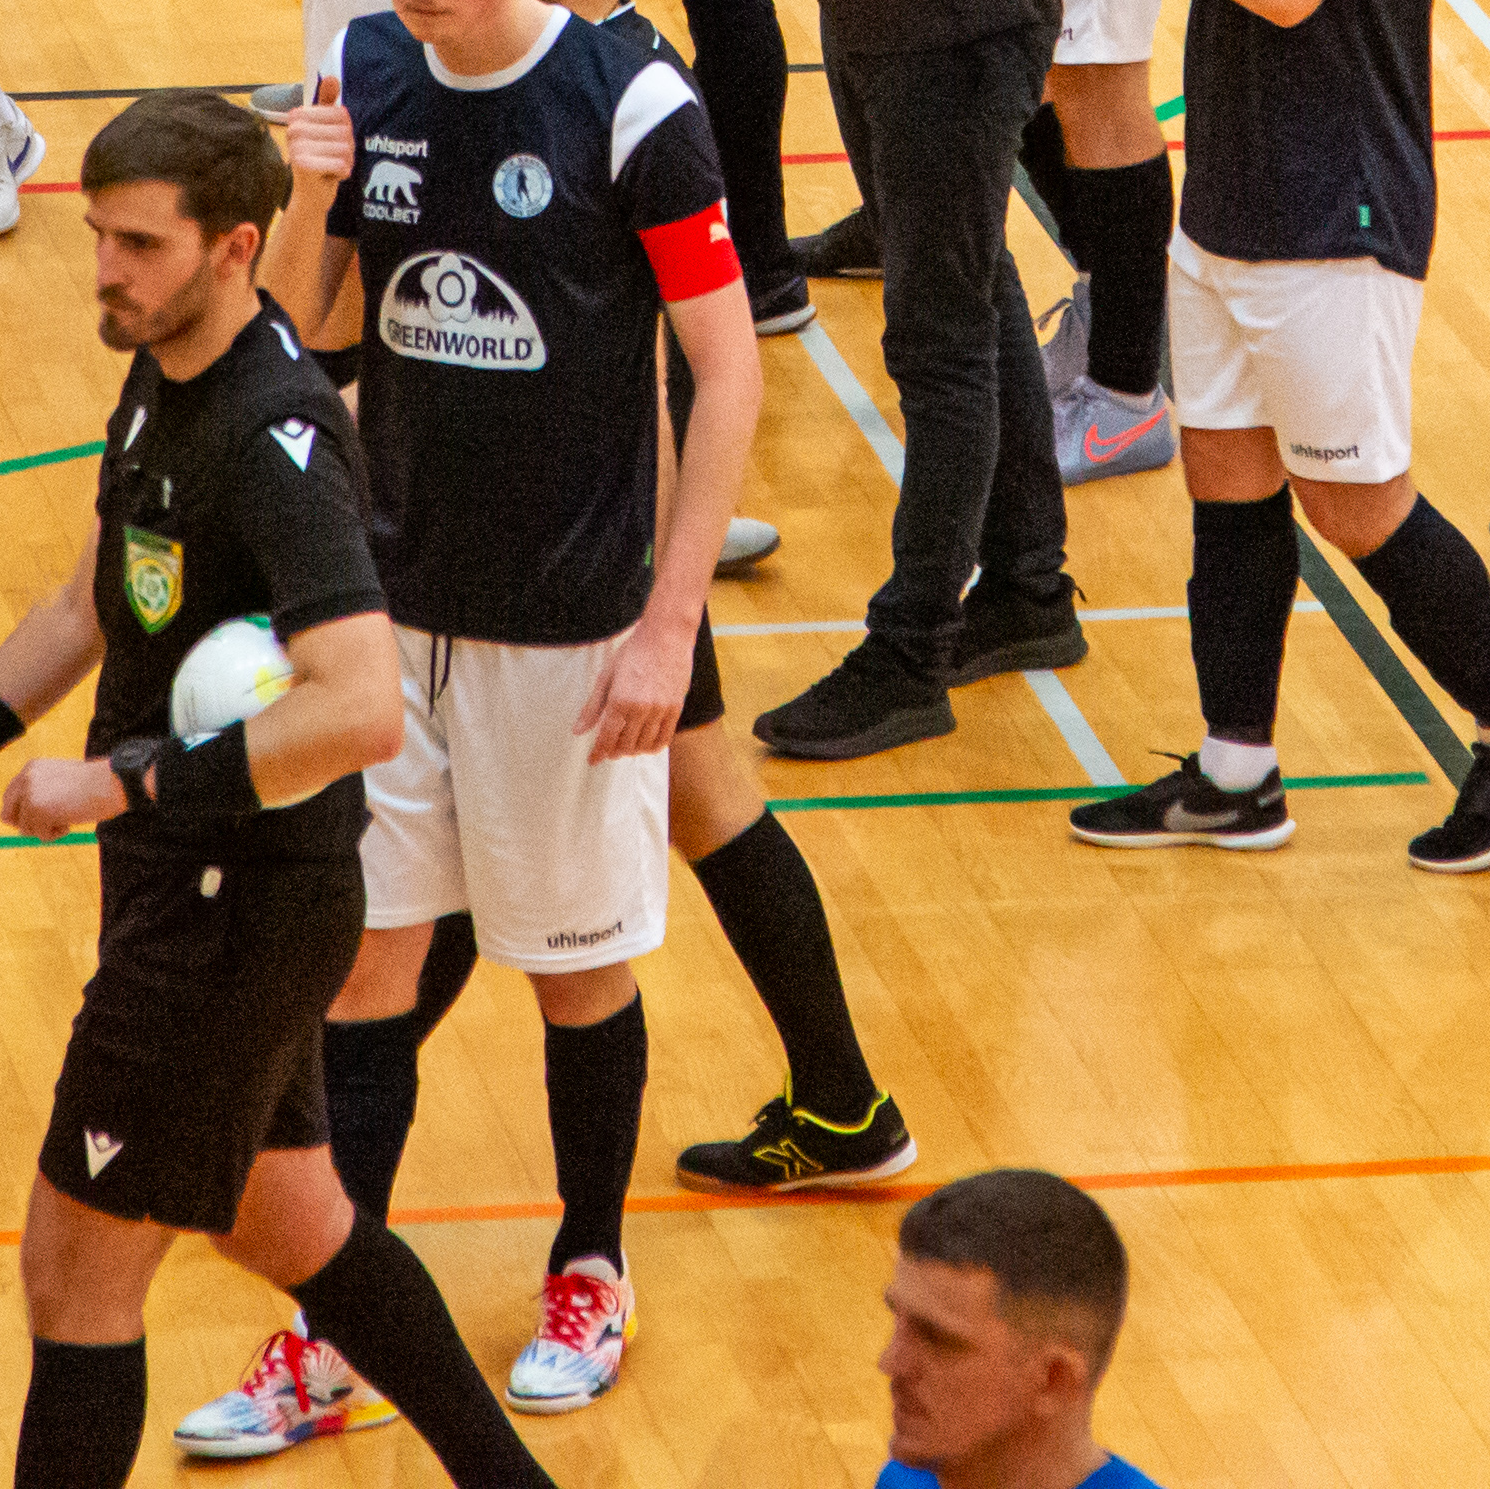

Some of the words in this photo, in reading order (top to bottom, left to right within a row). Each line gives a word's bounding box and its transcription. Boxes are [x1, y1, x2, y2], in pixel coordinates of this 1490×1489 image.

[364, 134, 429, 159] uhlsport
[387, 318, 533, 362] GREENWORLD
[1290, 443, 1360, 465] uhlsport
[547, 919, 623, 950] uhlsport
